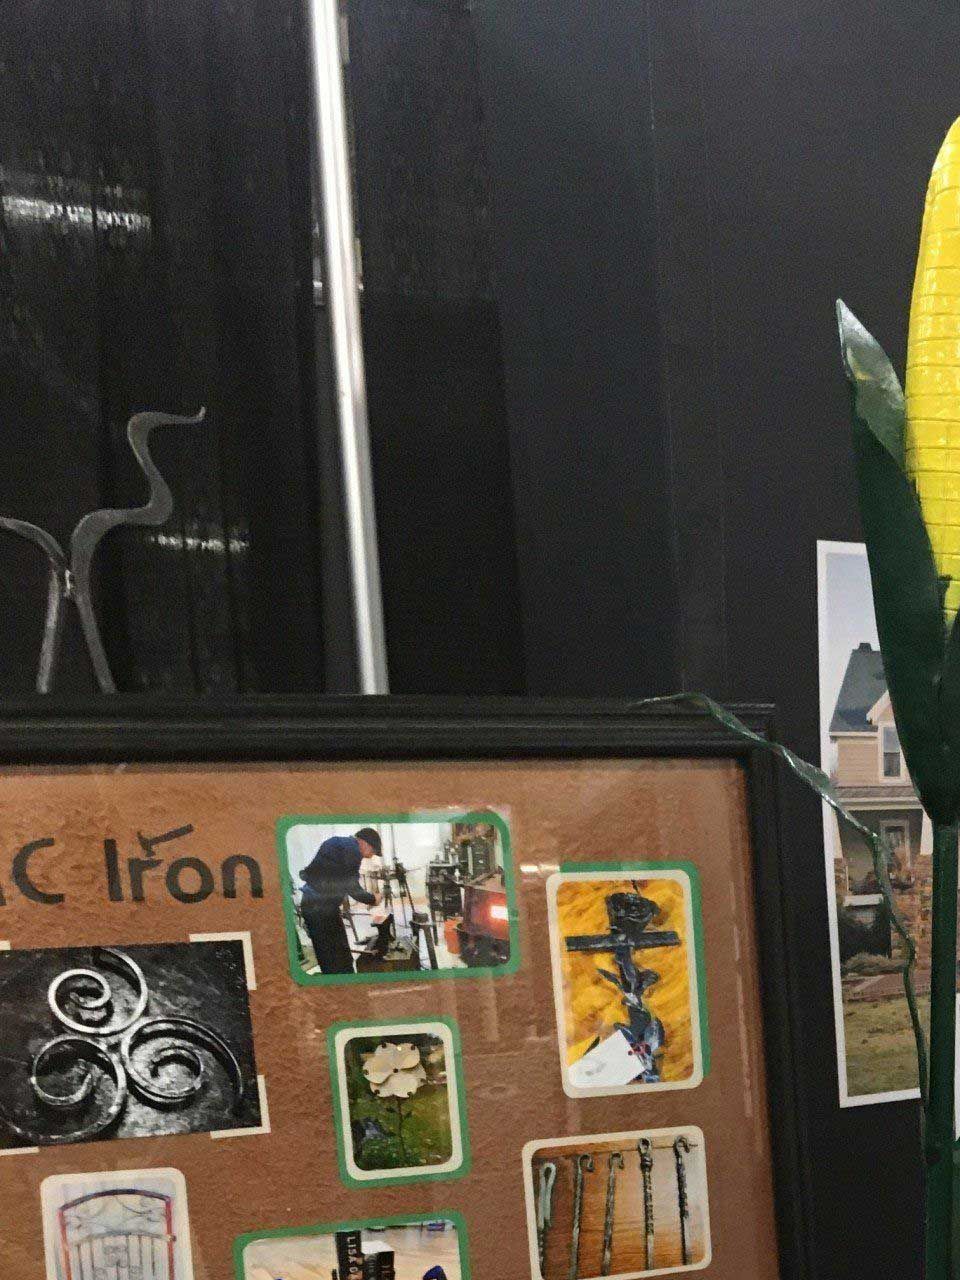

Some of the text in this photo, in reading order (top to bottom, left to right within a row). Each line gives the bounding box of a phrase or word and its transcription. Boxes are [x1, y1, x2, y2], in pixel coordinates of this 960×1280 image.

[0, 838, 264, 905] C Iron
[347, 1235, 360, 1264] LISA
